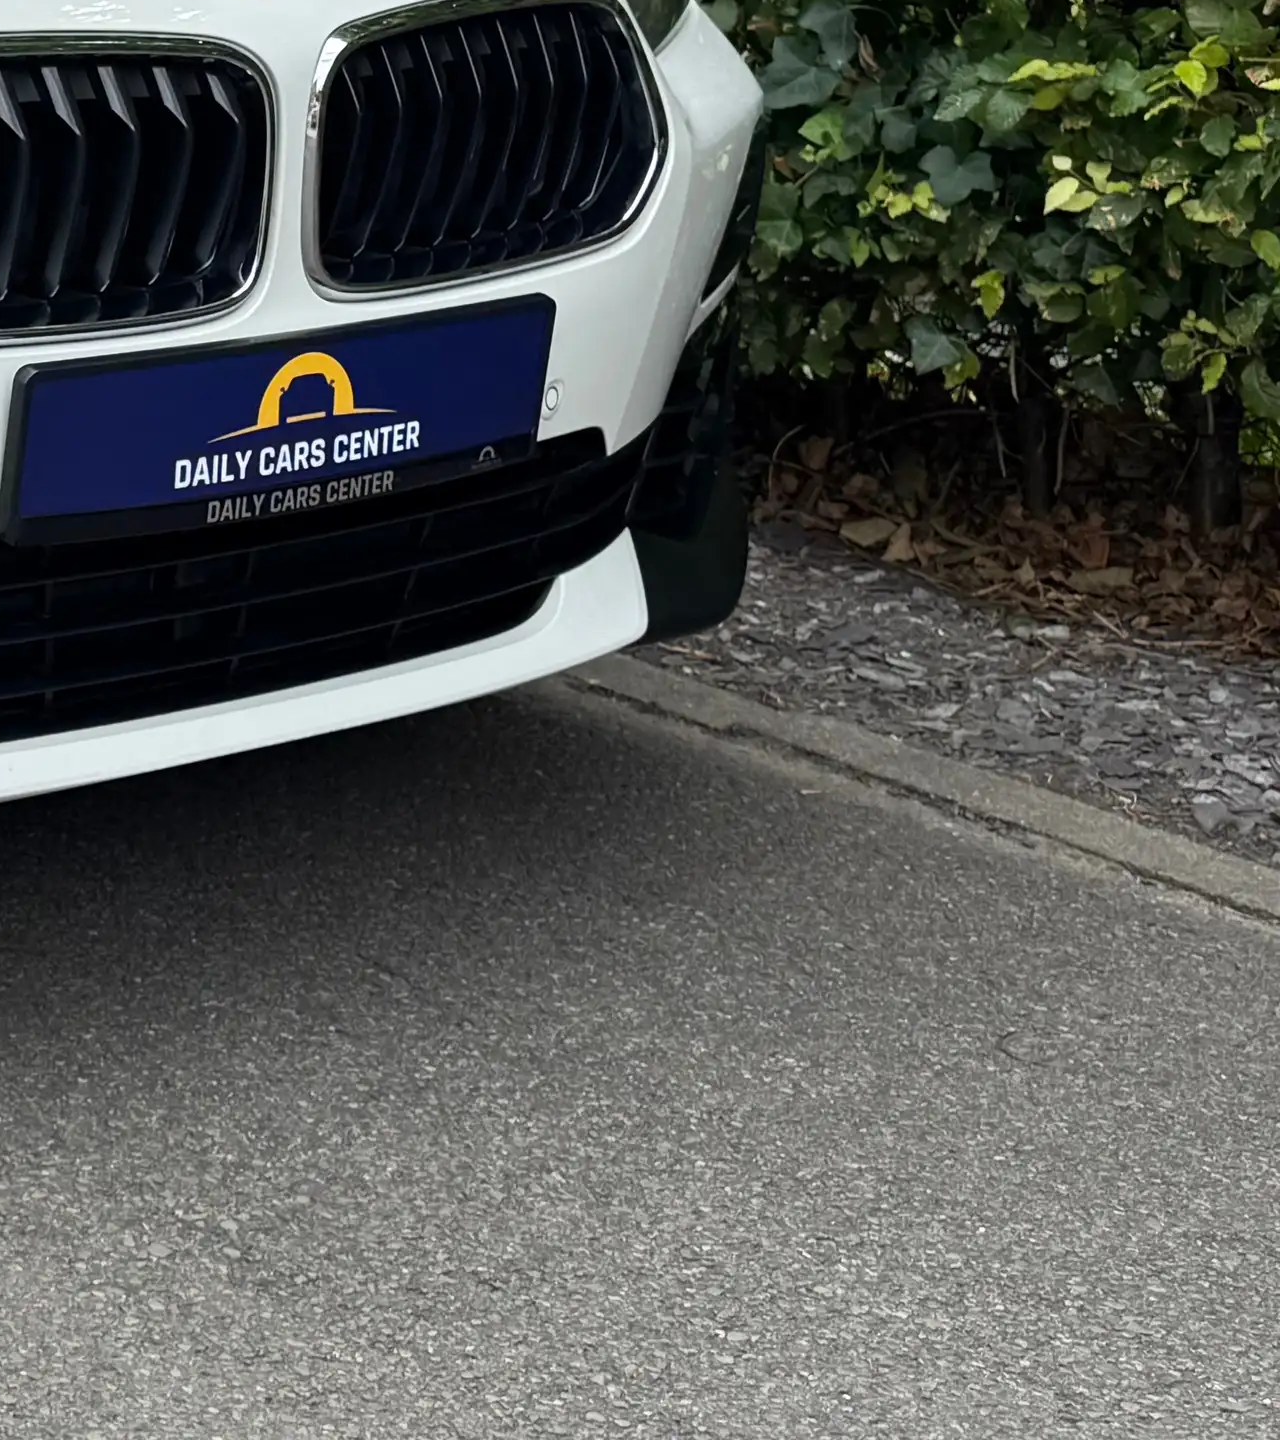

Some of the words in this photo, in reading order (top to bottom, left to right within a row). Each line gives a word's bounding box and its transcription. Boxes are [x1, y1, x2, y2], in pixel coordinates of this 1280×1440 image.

[173, 449, 253, 490] DAILY
[258, 438, 326, 477] CARS
[332, 420, 420, 464] CENTER
[206, 493, 266, 524] DAILY
[269, 481, 321, 513] CARS
[325, 470, 395, 503] CENTER
